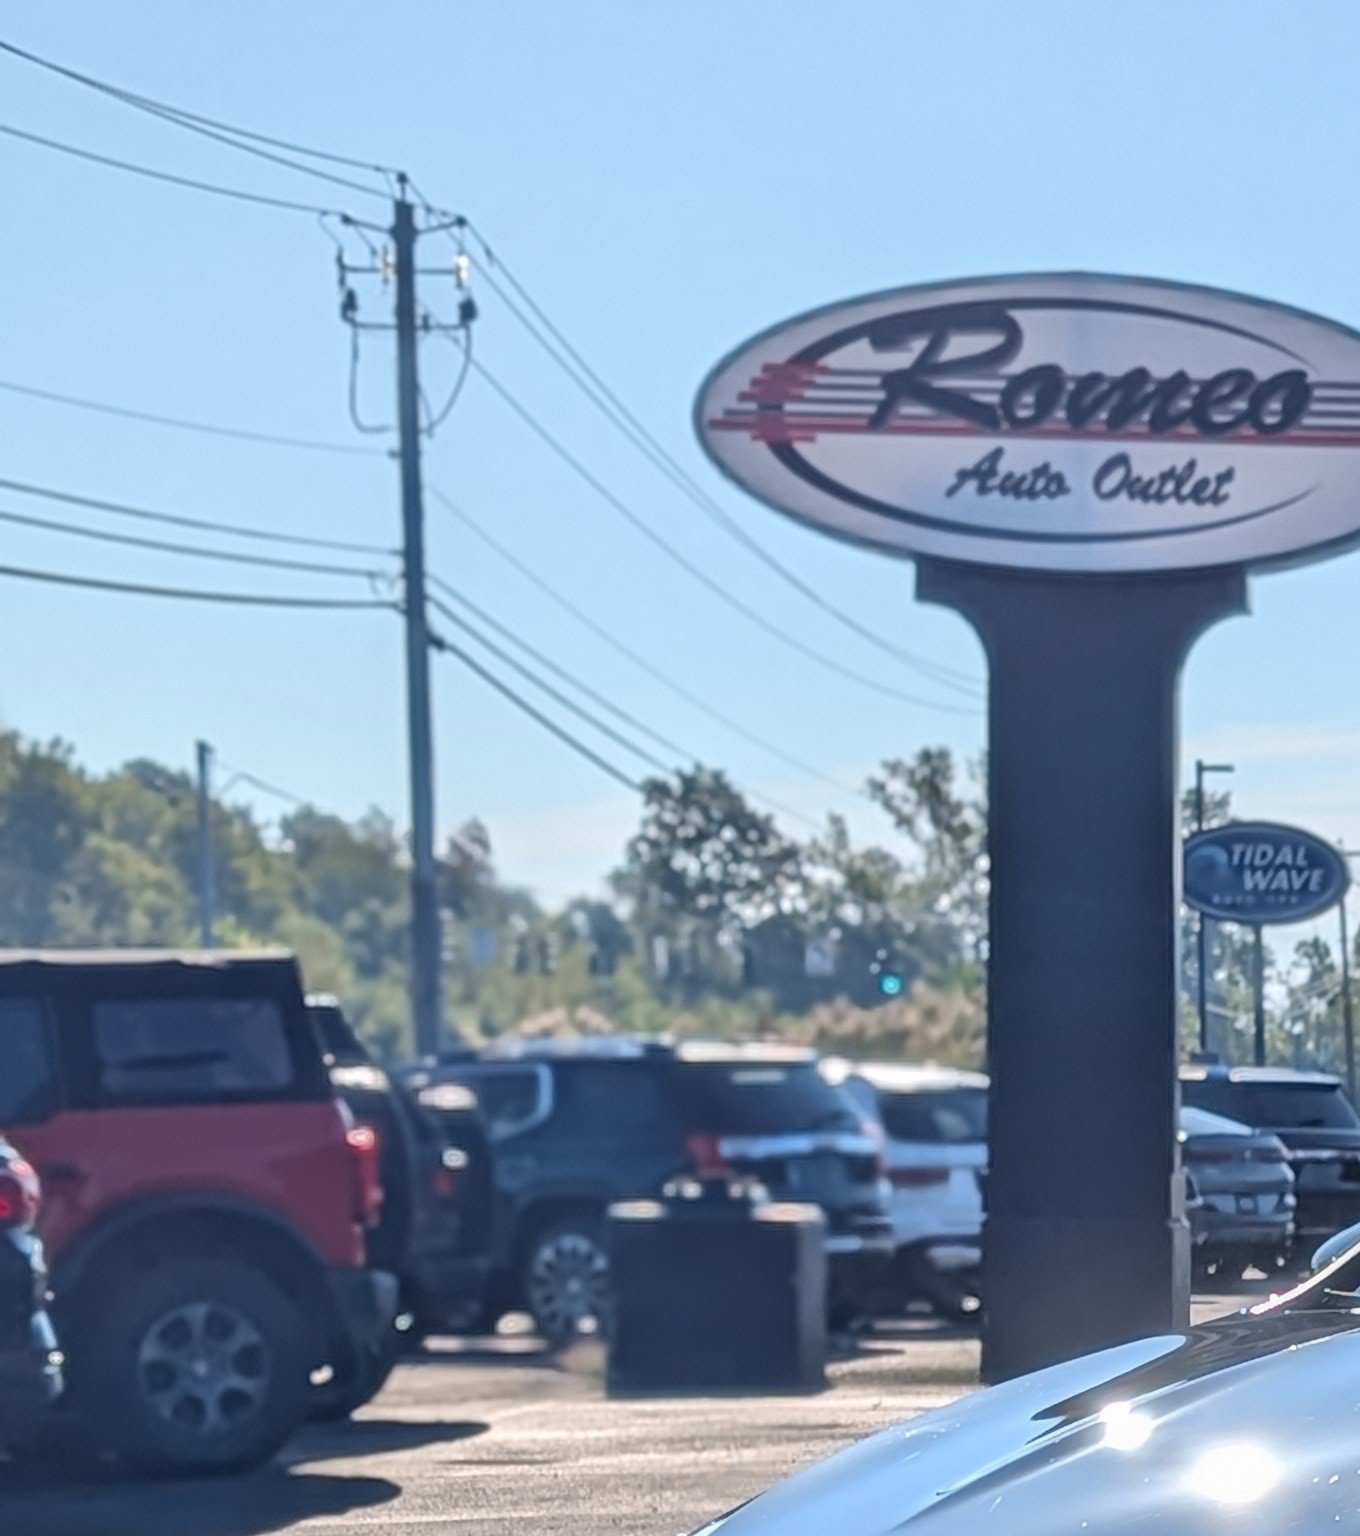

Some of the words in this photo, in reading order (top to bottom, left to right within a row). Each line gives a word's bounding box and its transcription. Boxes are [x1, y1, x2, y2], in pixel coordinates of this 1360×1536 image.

[868, 300, 1314, 436] Romeo
[945, 446, 1071, 500] Auto
[1091, 452, 1235, 506] Outlet
[1231, 843, 1308, 867] TIDAL
[1243, 867, 1325, 892] WAVE
